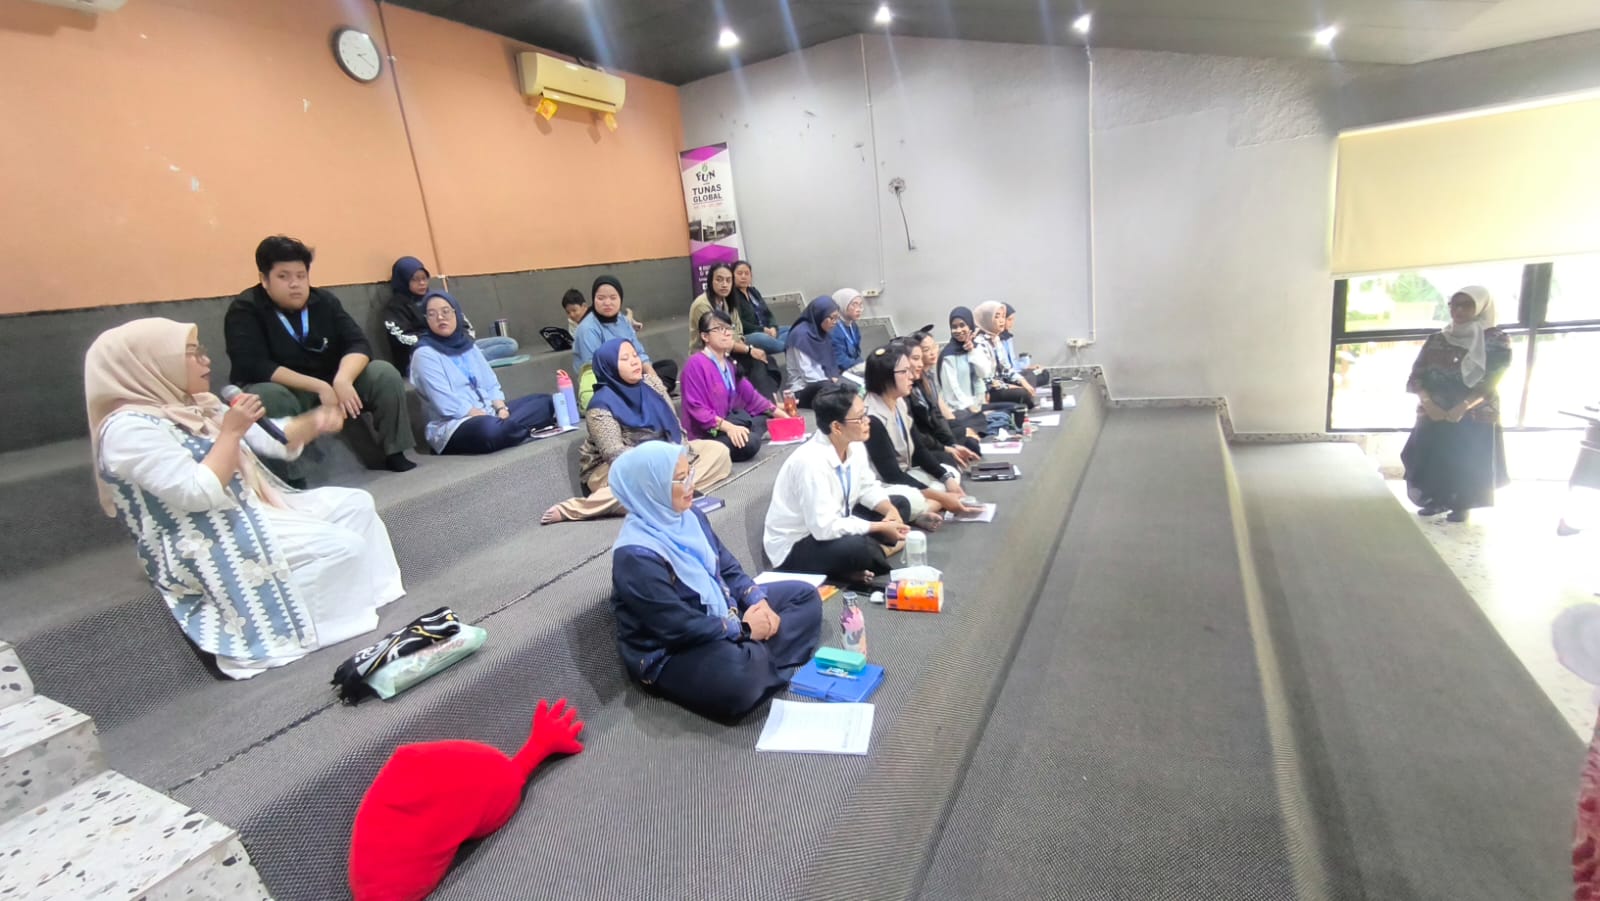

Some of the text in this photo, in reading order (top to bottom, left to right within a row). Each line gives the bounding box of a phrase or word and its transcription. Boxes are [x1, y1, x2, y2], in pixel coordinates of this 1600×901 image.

[695, 169, 716, 182] FUN
[692, 183, 722, 196] TUNAS
[693, 193, 723, 203] GLOBAL
